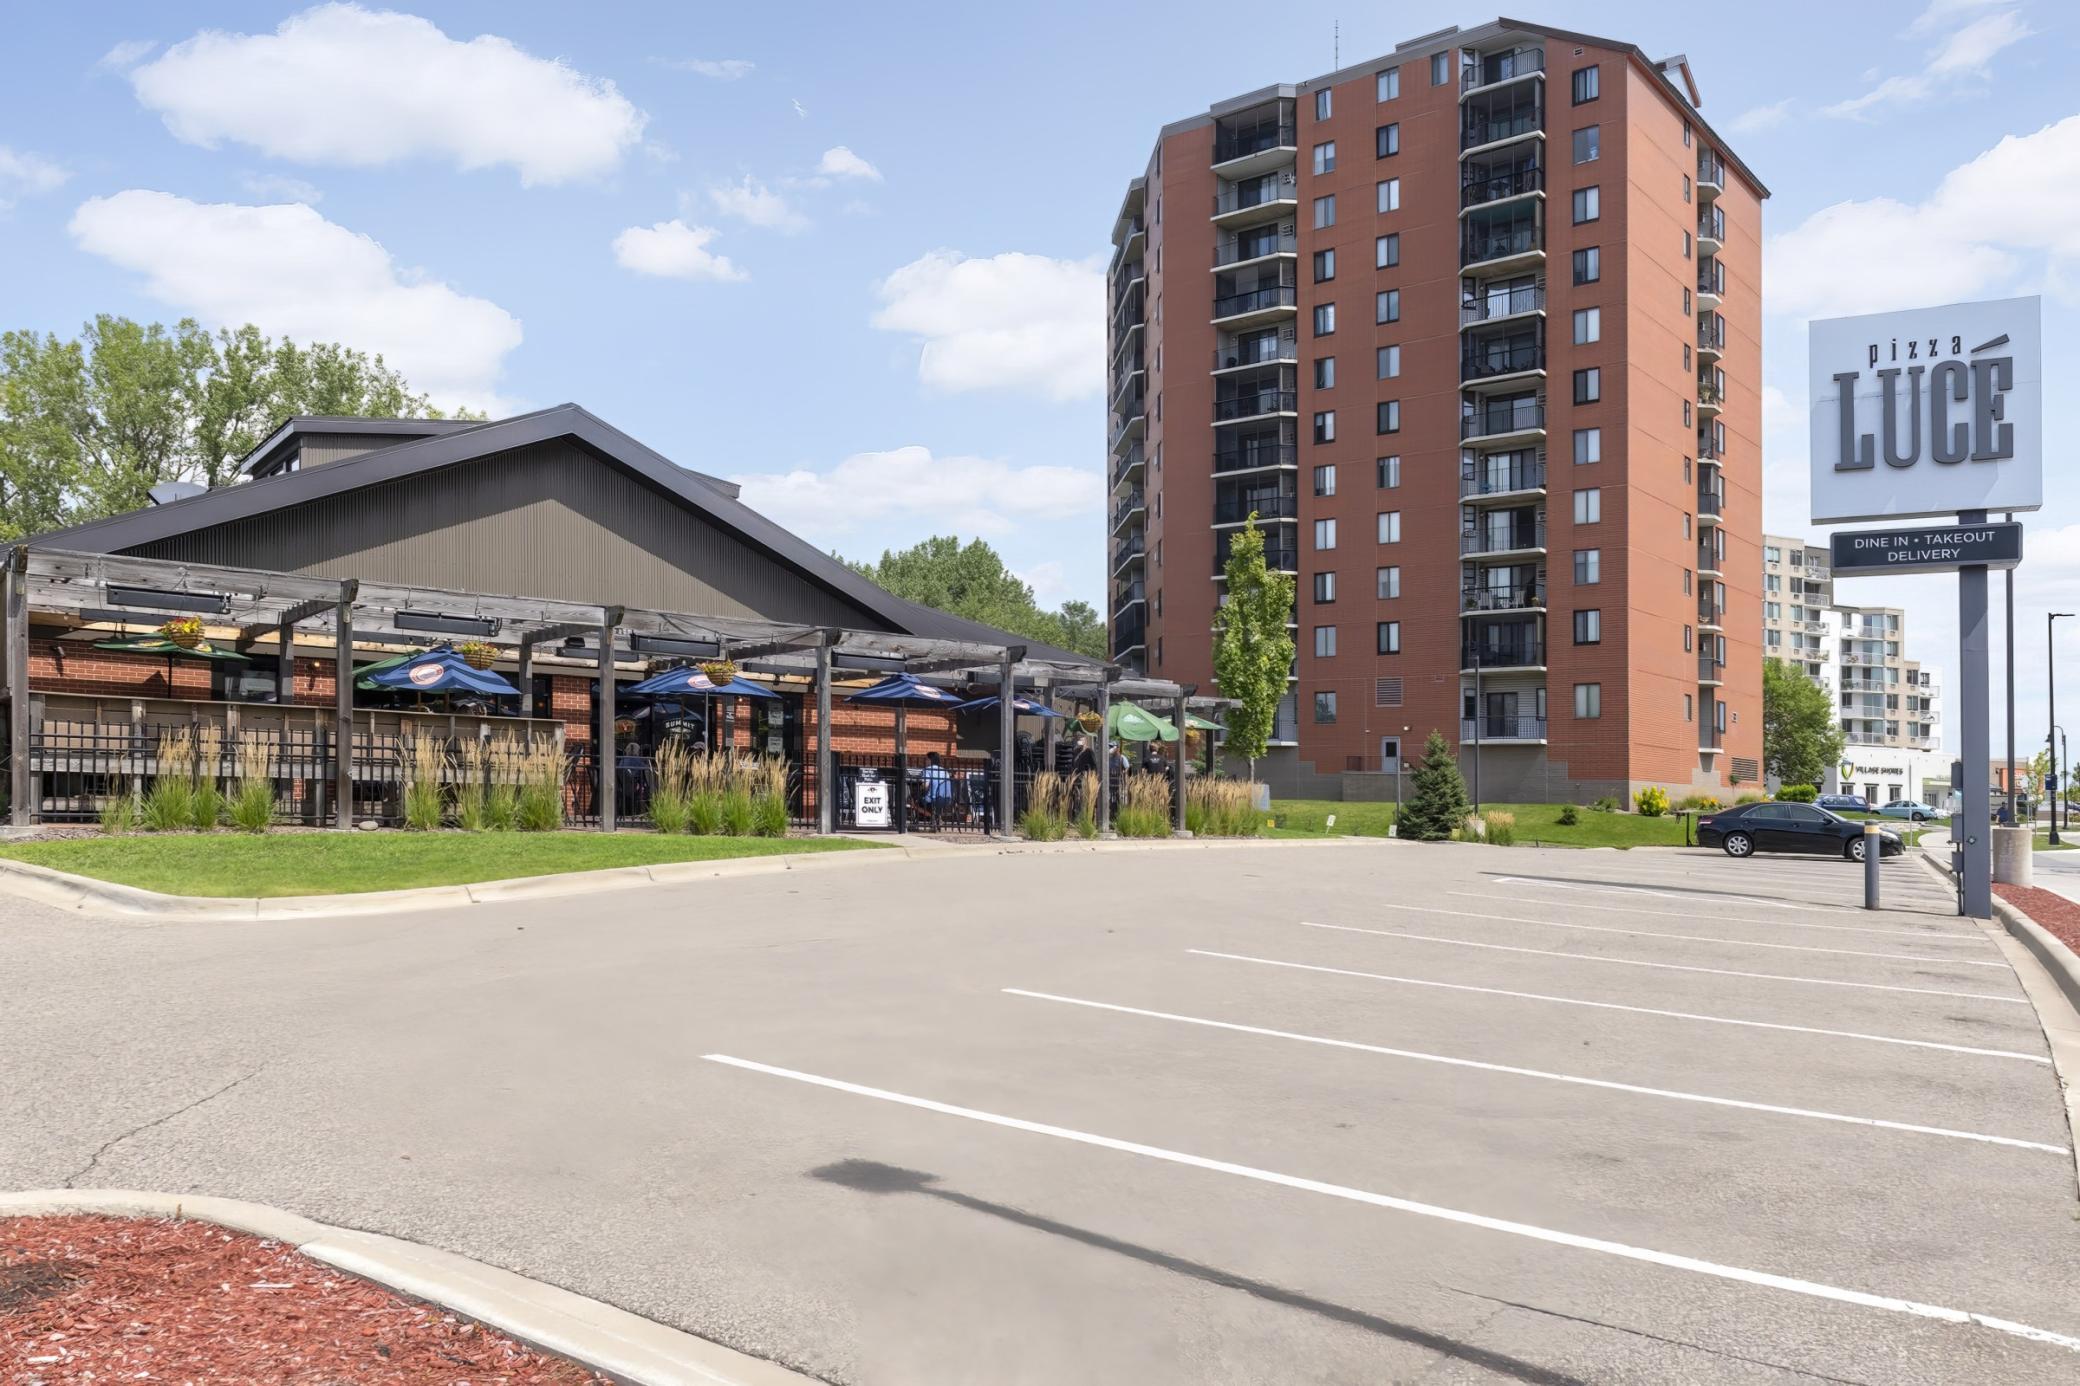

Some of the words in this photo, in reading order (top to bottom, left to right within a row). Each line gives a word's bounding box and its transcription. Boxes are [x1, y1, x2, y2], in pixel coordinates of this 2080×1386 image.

[1869, 335, 1961, 368] pizza
[1833, 333, 2014, 472] LUCÉ
[1854, 537, 1889, 549] DINE
[1894, 536, 1909, 546] IN
[1924, 531, 1996, 544] TAKEOUT
[1887, 548, 1960, 561] DELIVERY
[665, 720, 695, 729] SUMMIT
